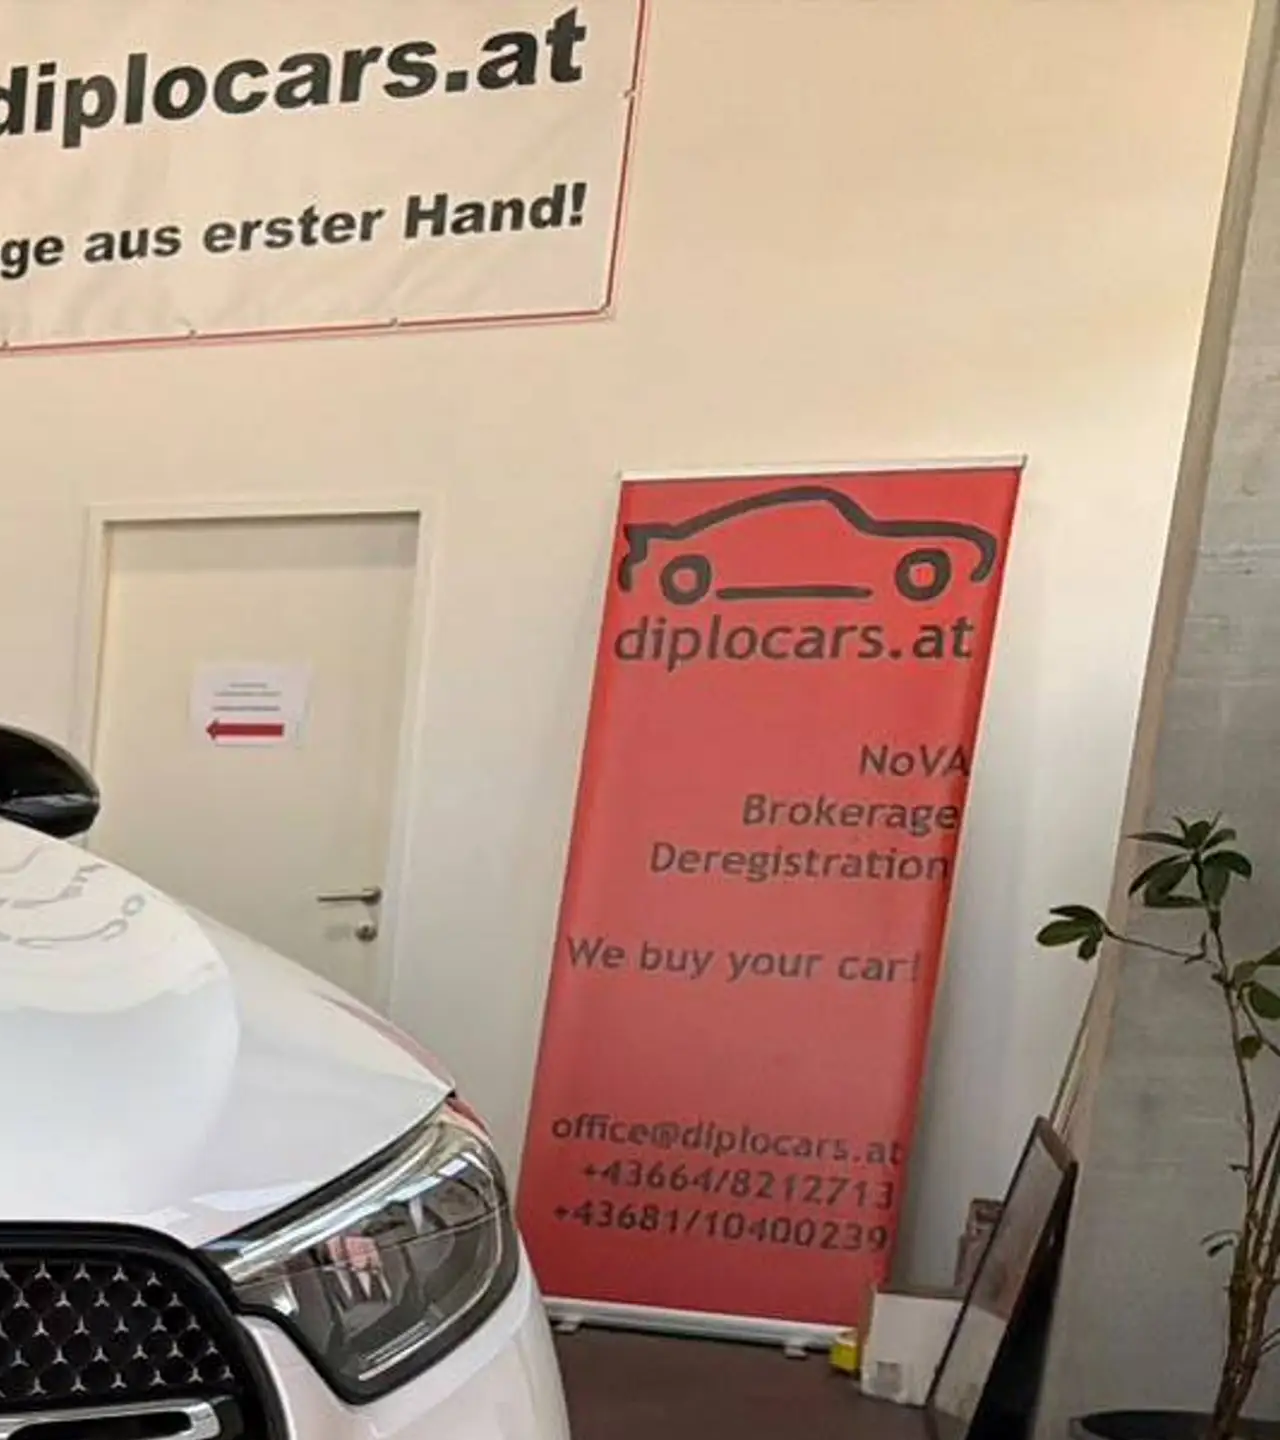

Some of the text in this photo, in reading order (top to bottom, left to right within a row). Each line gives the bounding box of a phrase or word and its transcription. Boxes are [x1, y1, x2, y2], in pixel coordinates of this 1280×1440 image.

[83, 221, 182, 266] aus
[203, 204, 385, 255] erster
[404, 182, 588, 240] Hand!
[613, 614, 975, 673] diplocars.at
[860, 744, 970, 777] NoVA
[742, 794, 959, 837] Brokerage
[650, 842, 949, 882] Deregistration
[567, 936, 921, 984] We buy your car!
[551, 1113, 902, 1166] office@diplocars.at
[582, 1158, 895, 1211] +43664/8212713
